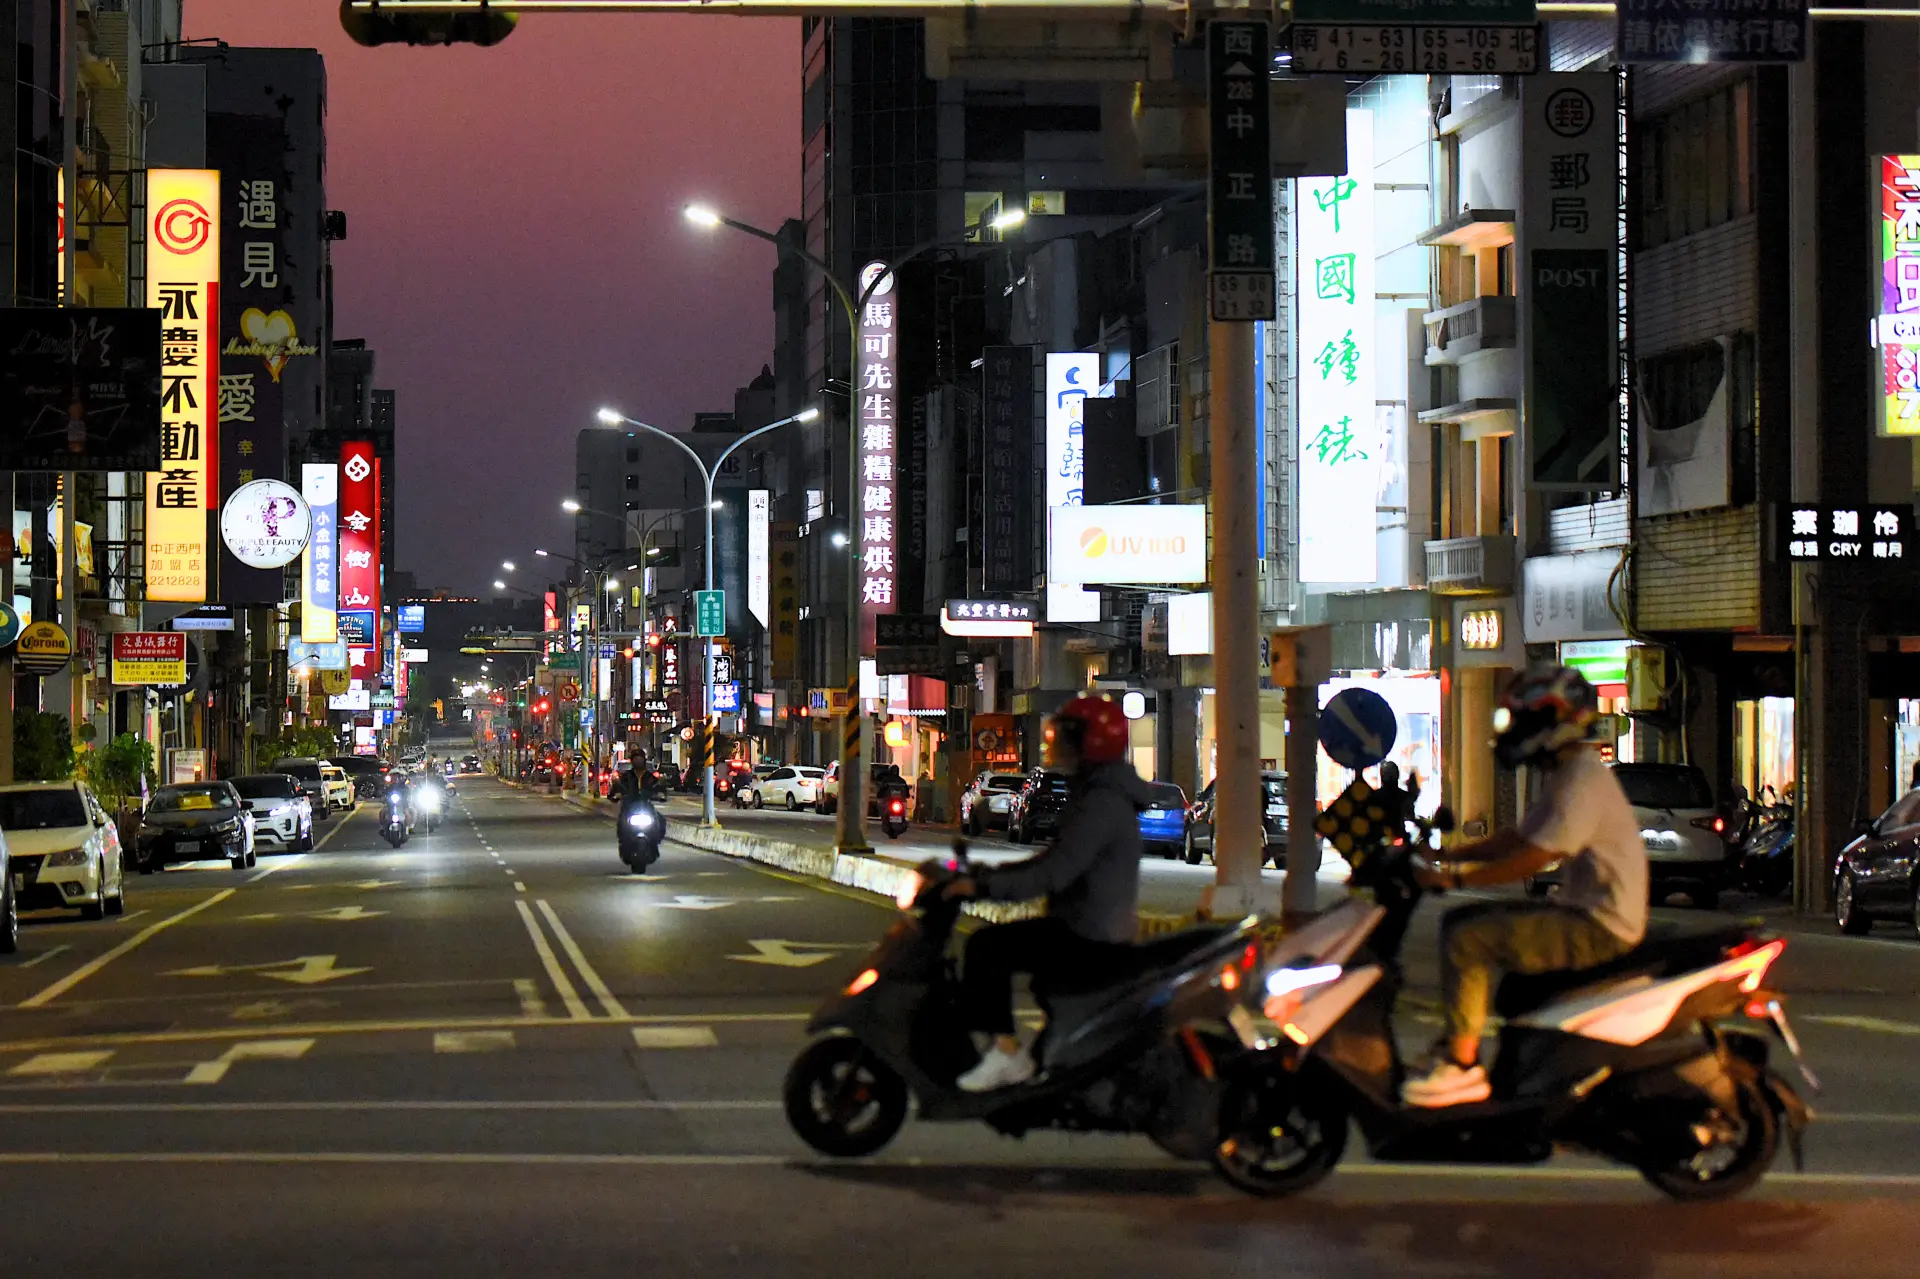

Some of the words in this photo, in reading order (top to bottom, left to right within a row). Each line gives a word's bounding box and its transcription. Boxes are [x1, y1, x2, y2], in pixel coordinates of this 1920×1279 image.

[1223, 27, 1254, 55] 西
[1295, 29, 1318, 51] 南
[1510, 29, 1536, 52] 北
[1423, 52, 1497, 70] 28-56
[1226, 108, 1256, 265] 中正路
[1549, 152, 1590, 234] 郵局
[238, 180, 277, 289] 遇見
[1538, 267, 1600, 288] POST
[1305, 175, 1368, 466] 中國鐘錶
[156, 281, 199, 509] 永慶不動產
[219, 373, 256, 423] 愛
[862, 301, 893, 605] 馬可先生雜糧健康烘焙
[150, 543, 201, 555] 中正西門
[1111, 536, 1143, 555] UV
[1829, 542, 1861, 556] CRY
[150, 559, 201, 571] 加盟店
[150, 575, 201, 586] 2212828
[22, 634, 65, 650] Corona
[581, 710, 589, 723] P
